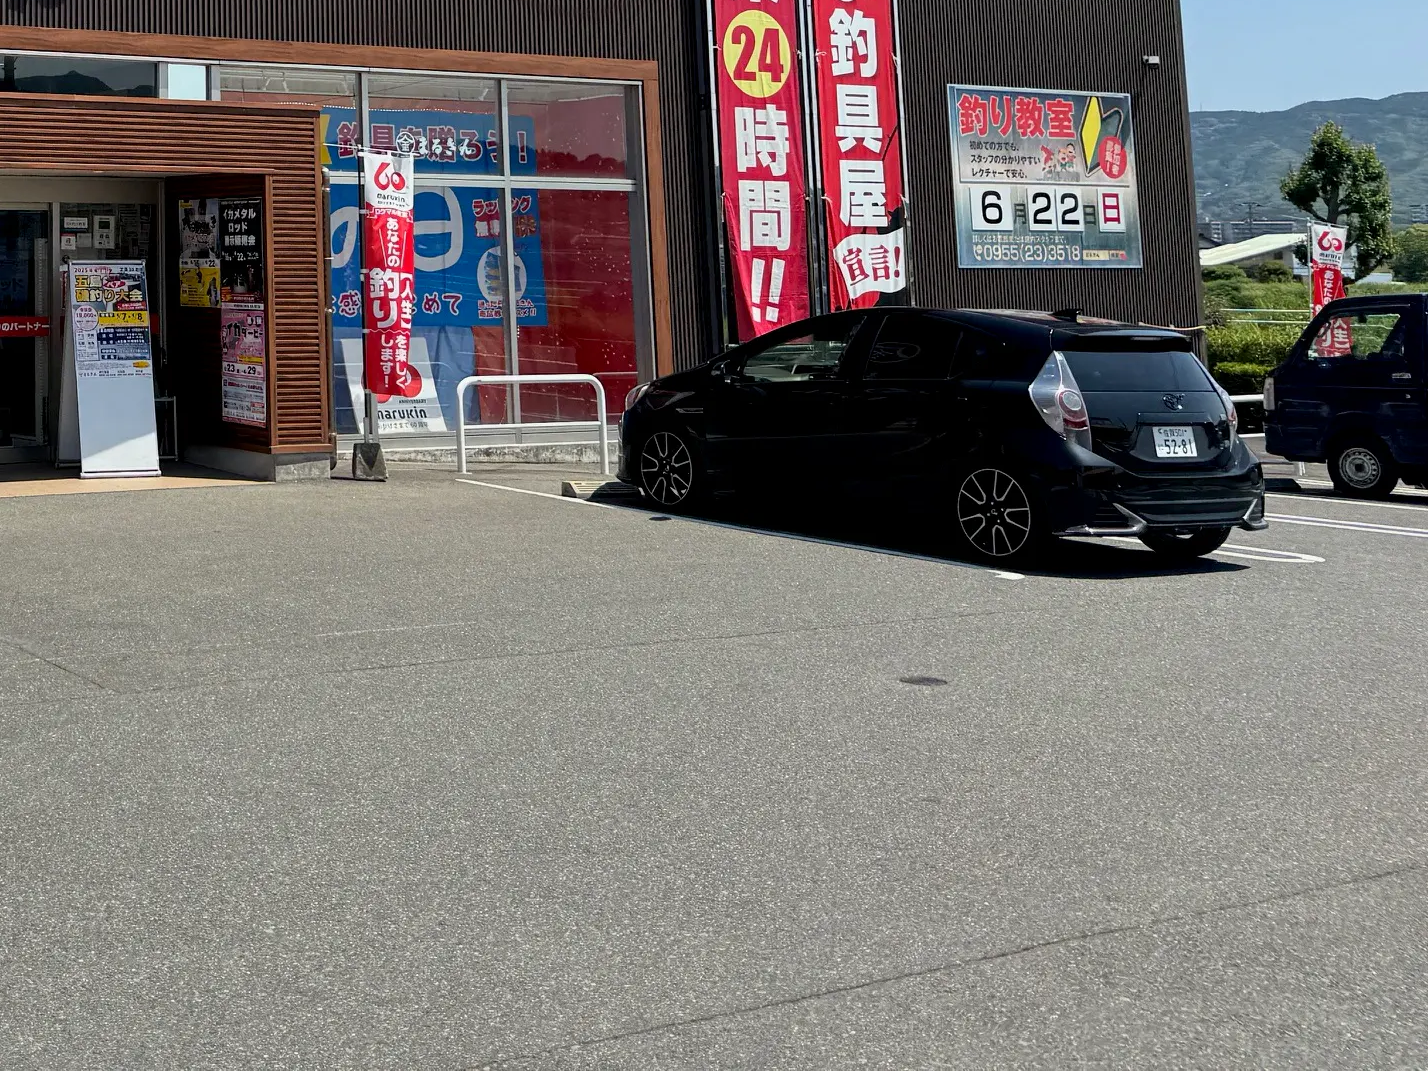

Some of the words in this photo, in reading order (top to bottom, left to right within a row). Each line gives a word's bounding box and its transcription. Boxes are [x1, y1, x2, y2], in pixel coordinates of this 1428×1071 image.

[957, 93, 1077, 139] 釣り教室
[970, 155, 1041, 165] スタッフの分かりやすい
[983, 244, 1081, 261] 0955(23)3518
